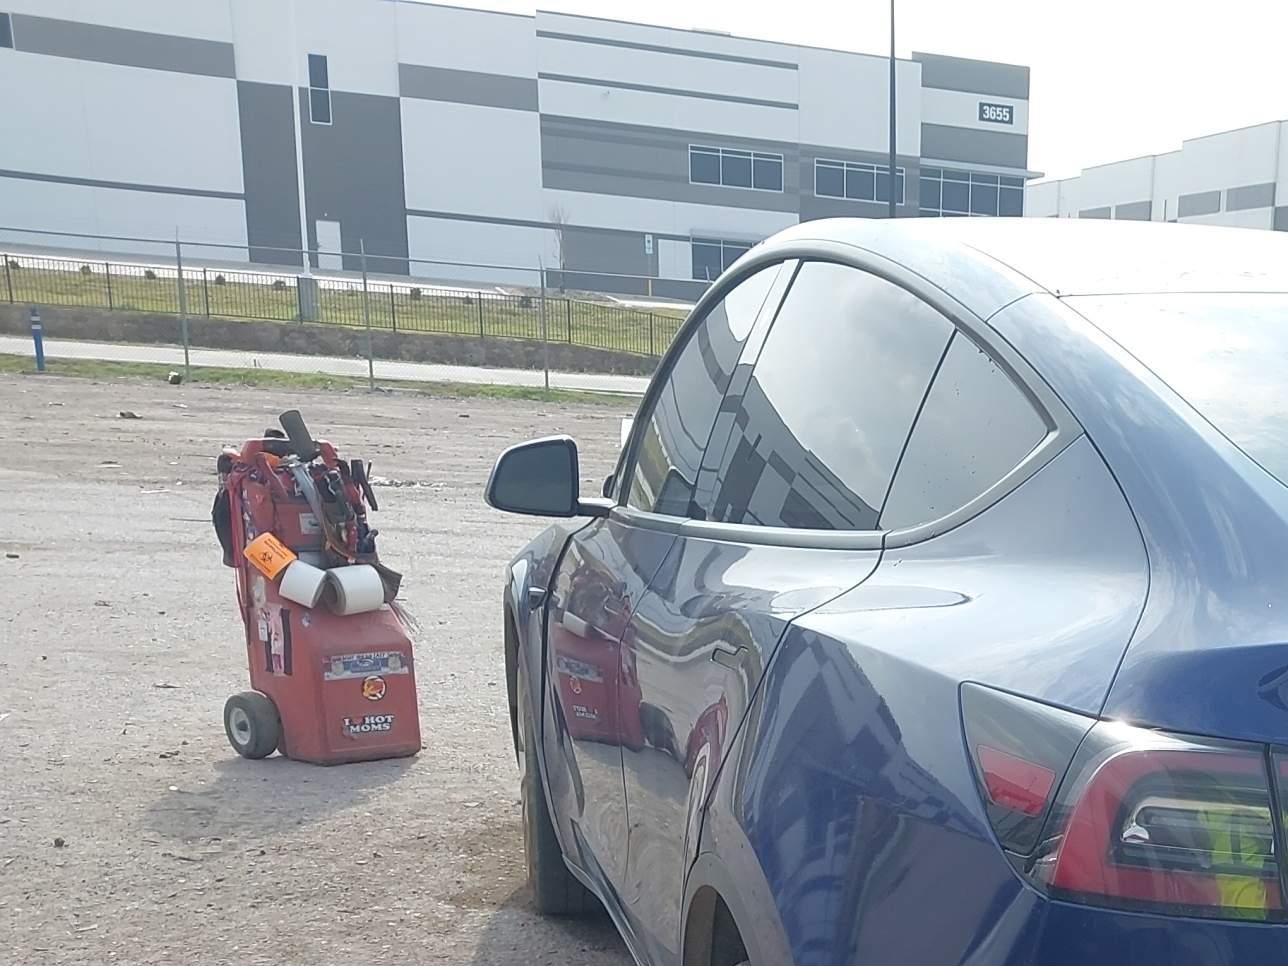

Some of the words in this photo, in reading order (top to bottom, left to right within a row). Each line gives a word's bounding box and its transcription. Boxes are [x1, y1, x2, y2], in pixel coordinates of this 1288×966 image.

[982, 105, 1010, 121] 3655
[344, 718, 350, 726] I
[364, 715, 395, 724] HOT
[350, 723, 391, 733] MOMS
